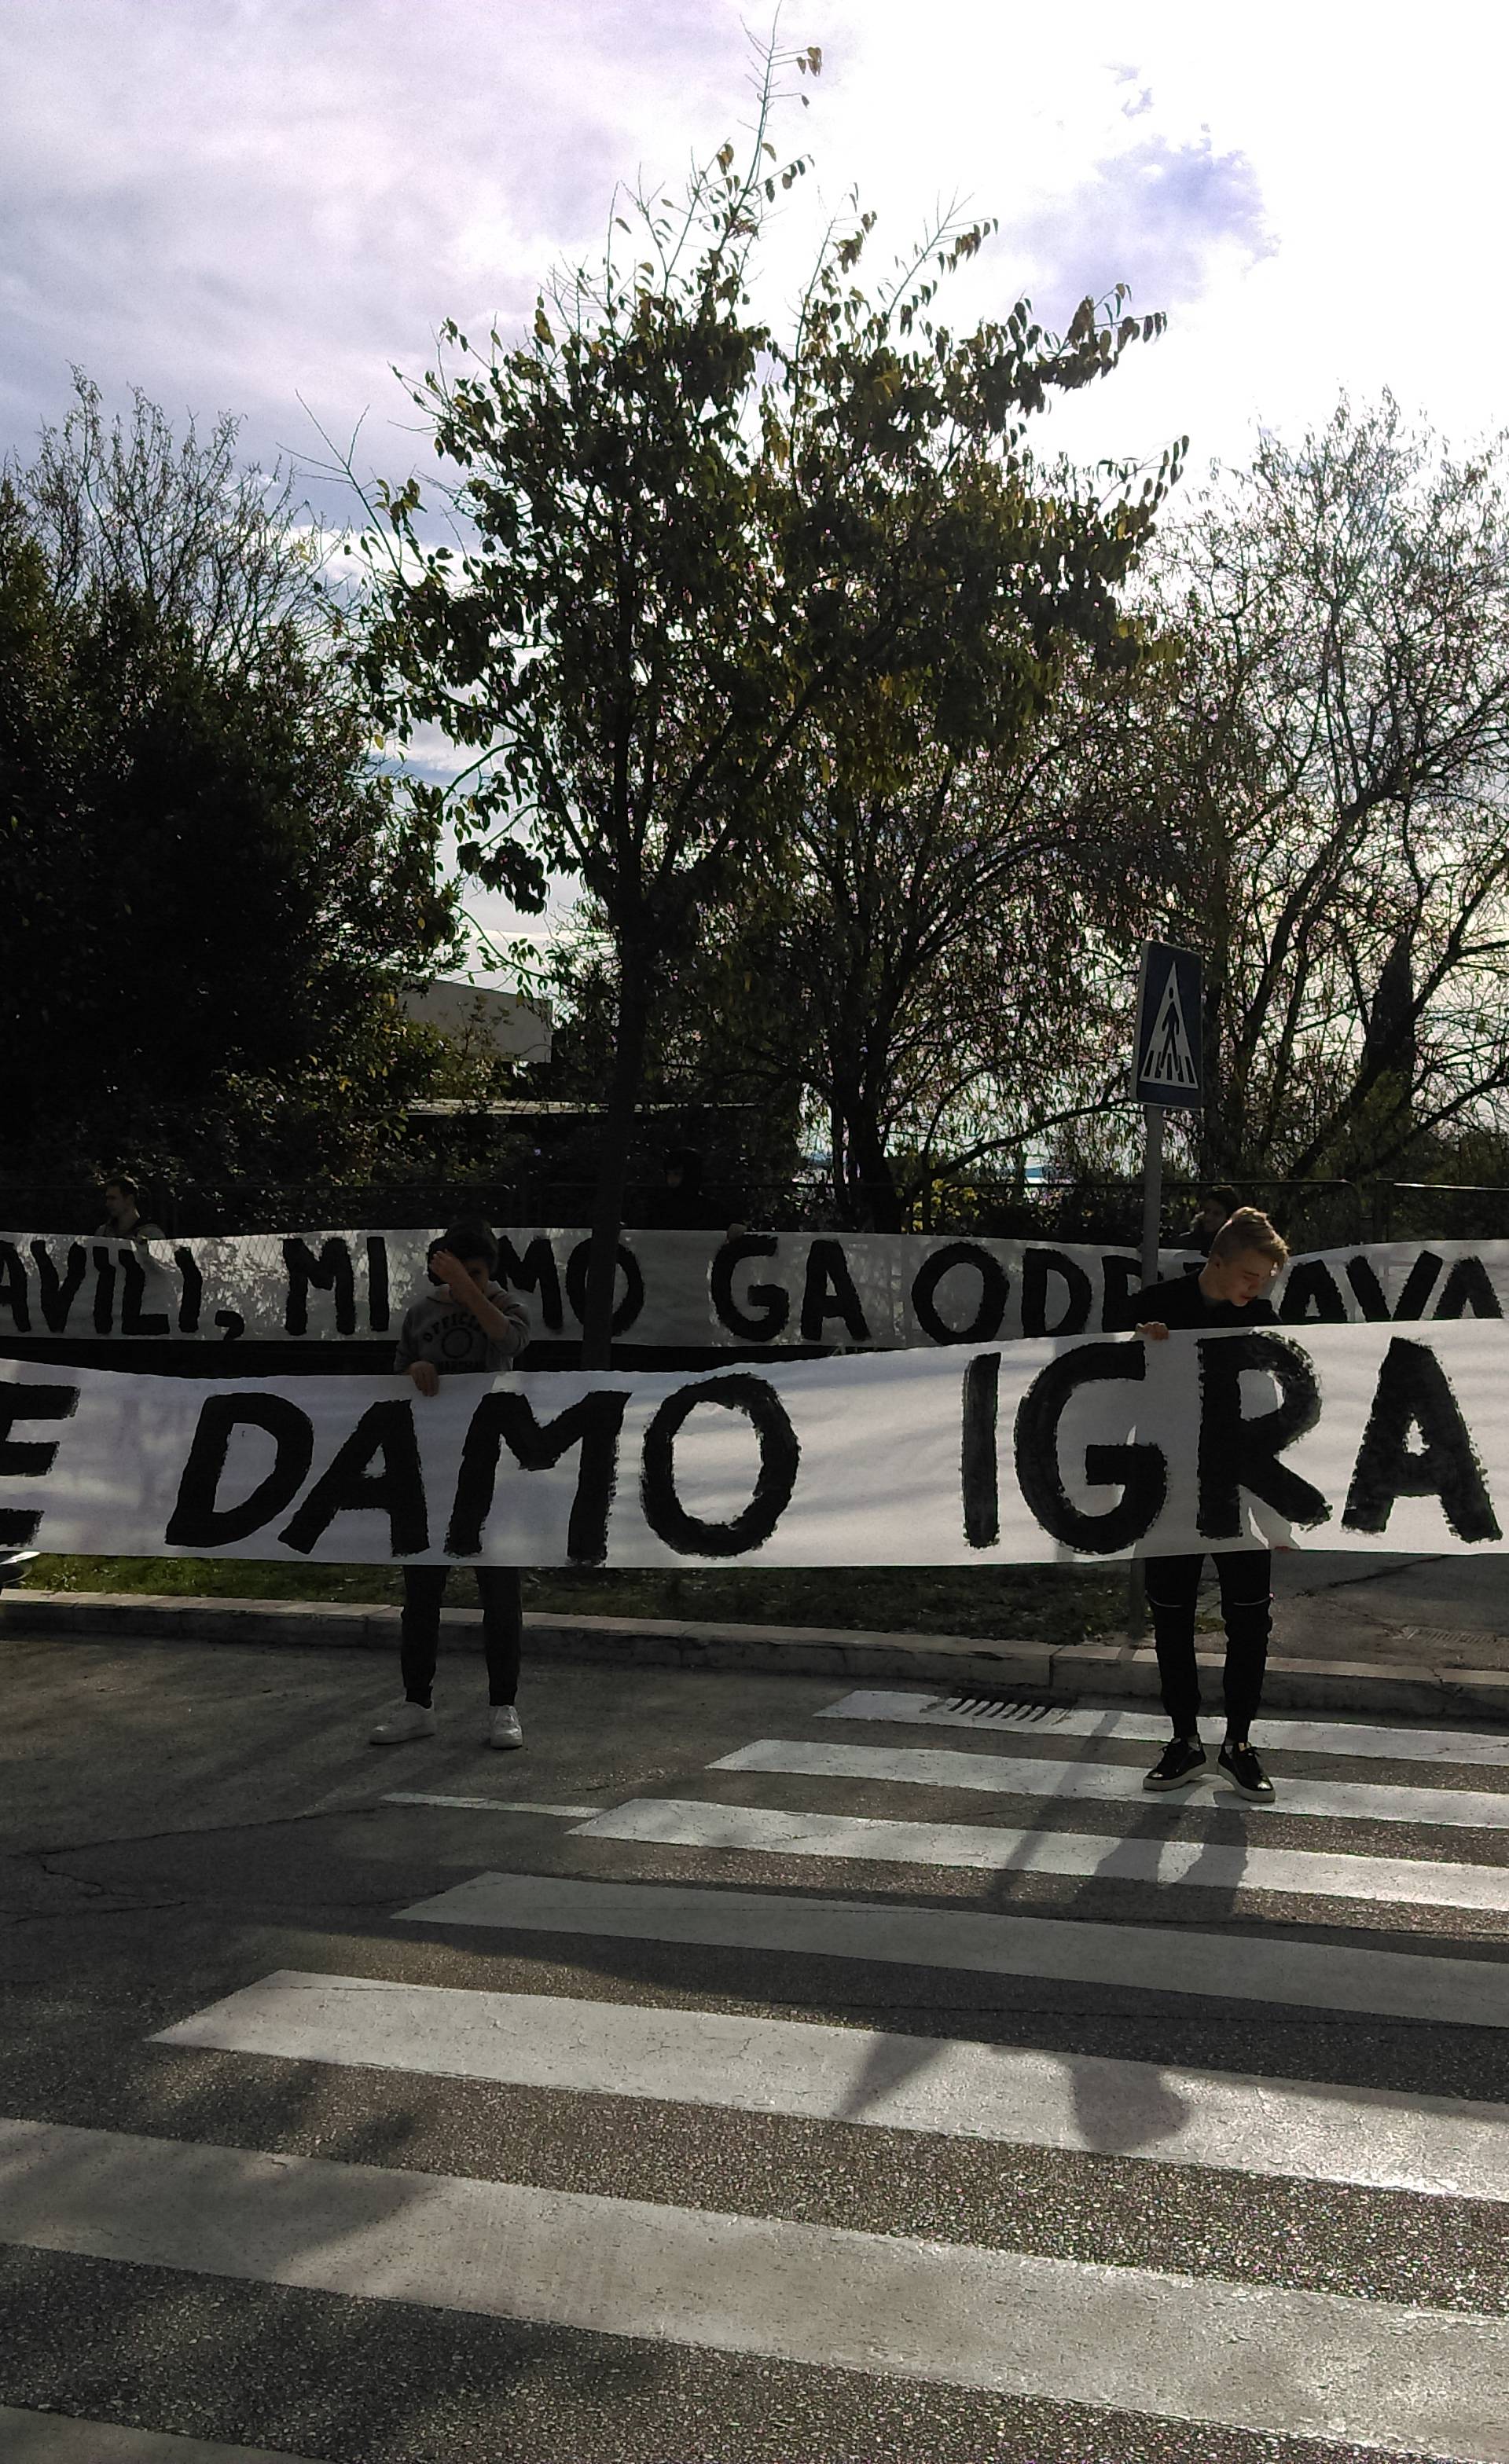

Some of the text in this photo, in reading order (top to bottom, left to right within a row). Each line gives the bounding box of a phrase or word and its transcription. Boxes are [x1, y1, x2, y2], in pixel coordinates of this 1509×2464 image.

[282, 1236, 390, 1336] MI
[428, 1235, 645, 1336] MO
[710, 1233, 872, 1342] GA
[165, 1372, 802, 1567] DAMO
[960, 1329, 1504, 1556] IGRA
